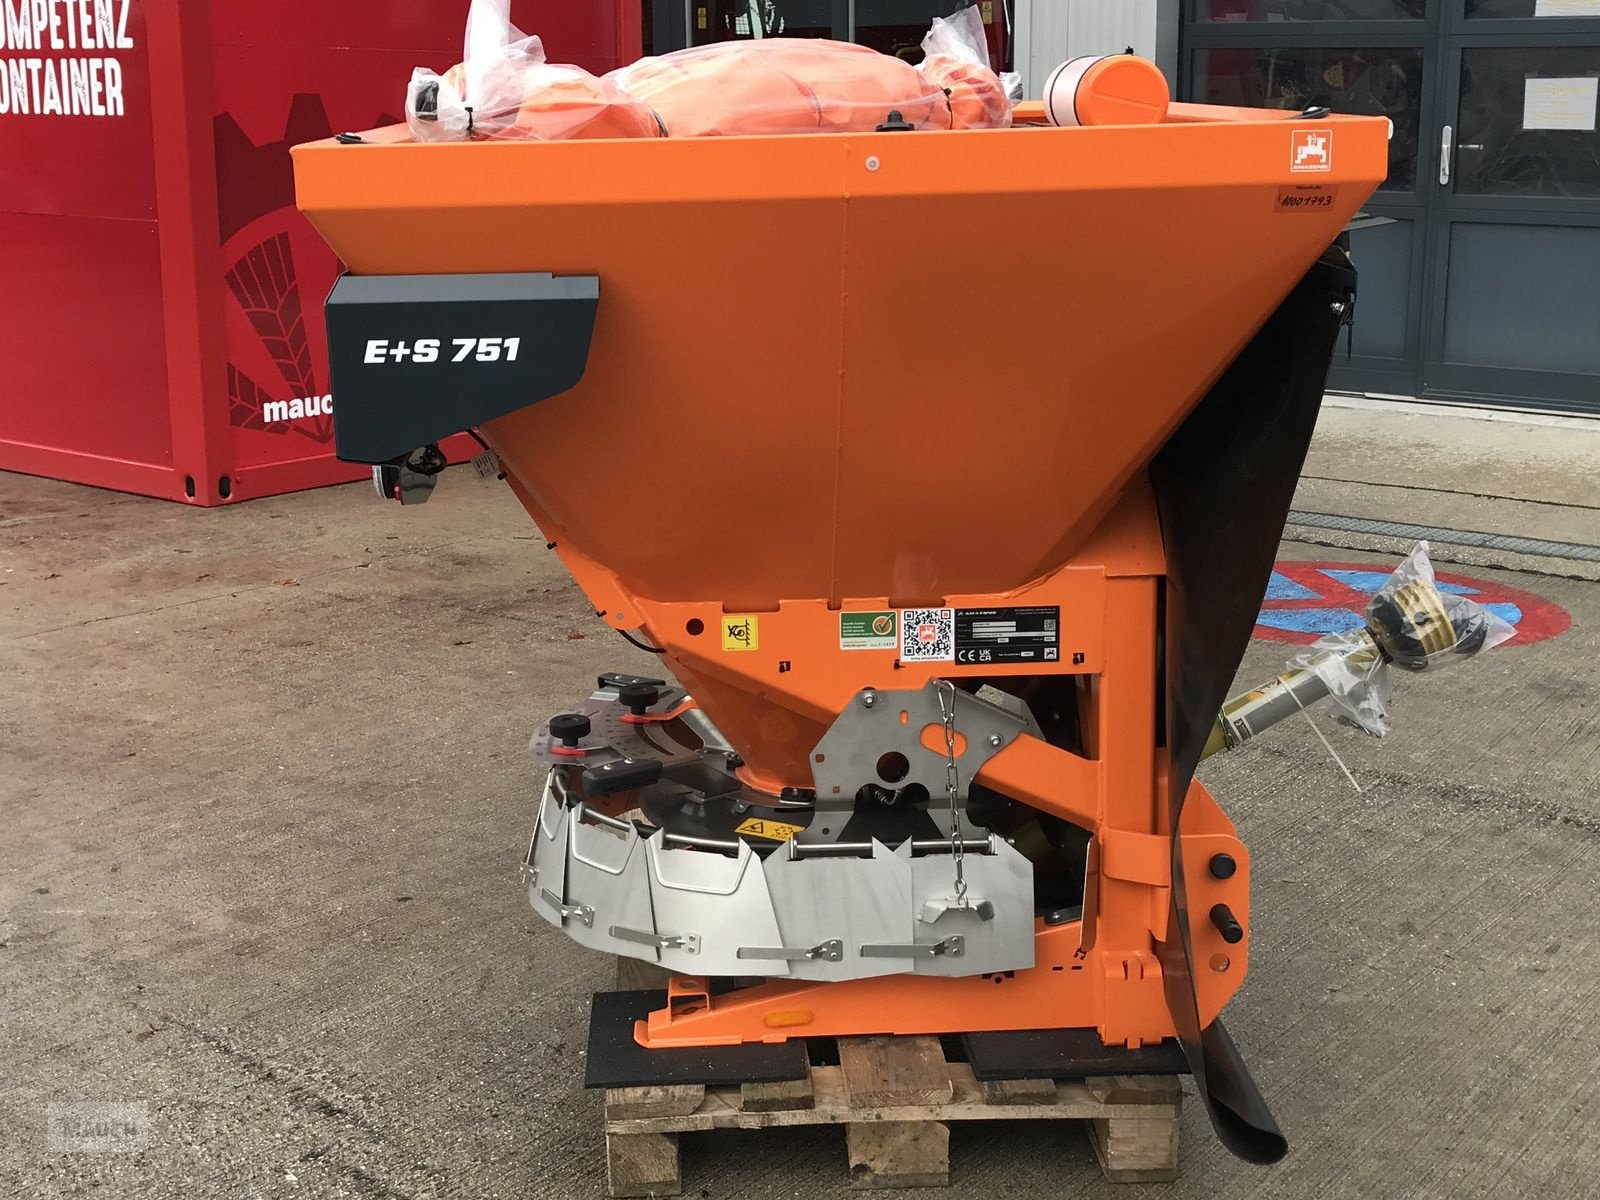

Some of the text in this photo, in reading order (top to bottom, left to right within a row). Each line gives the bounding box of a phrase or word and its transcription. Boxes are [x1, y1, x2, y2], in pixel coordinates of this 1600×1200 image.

[364, 337, 520, 364] E+S 751
[263, 394, 333, 422] mauc
[958, 650, 976, 662] CE
